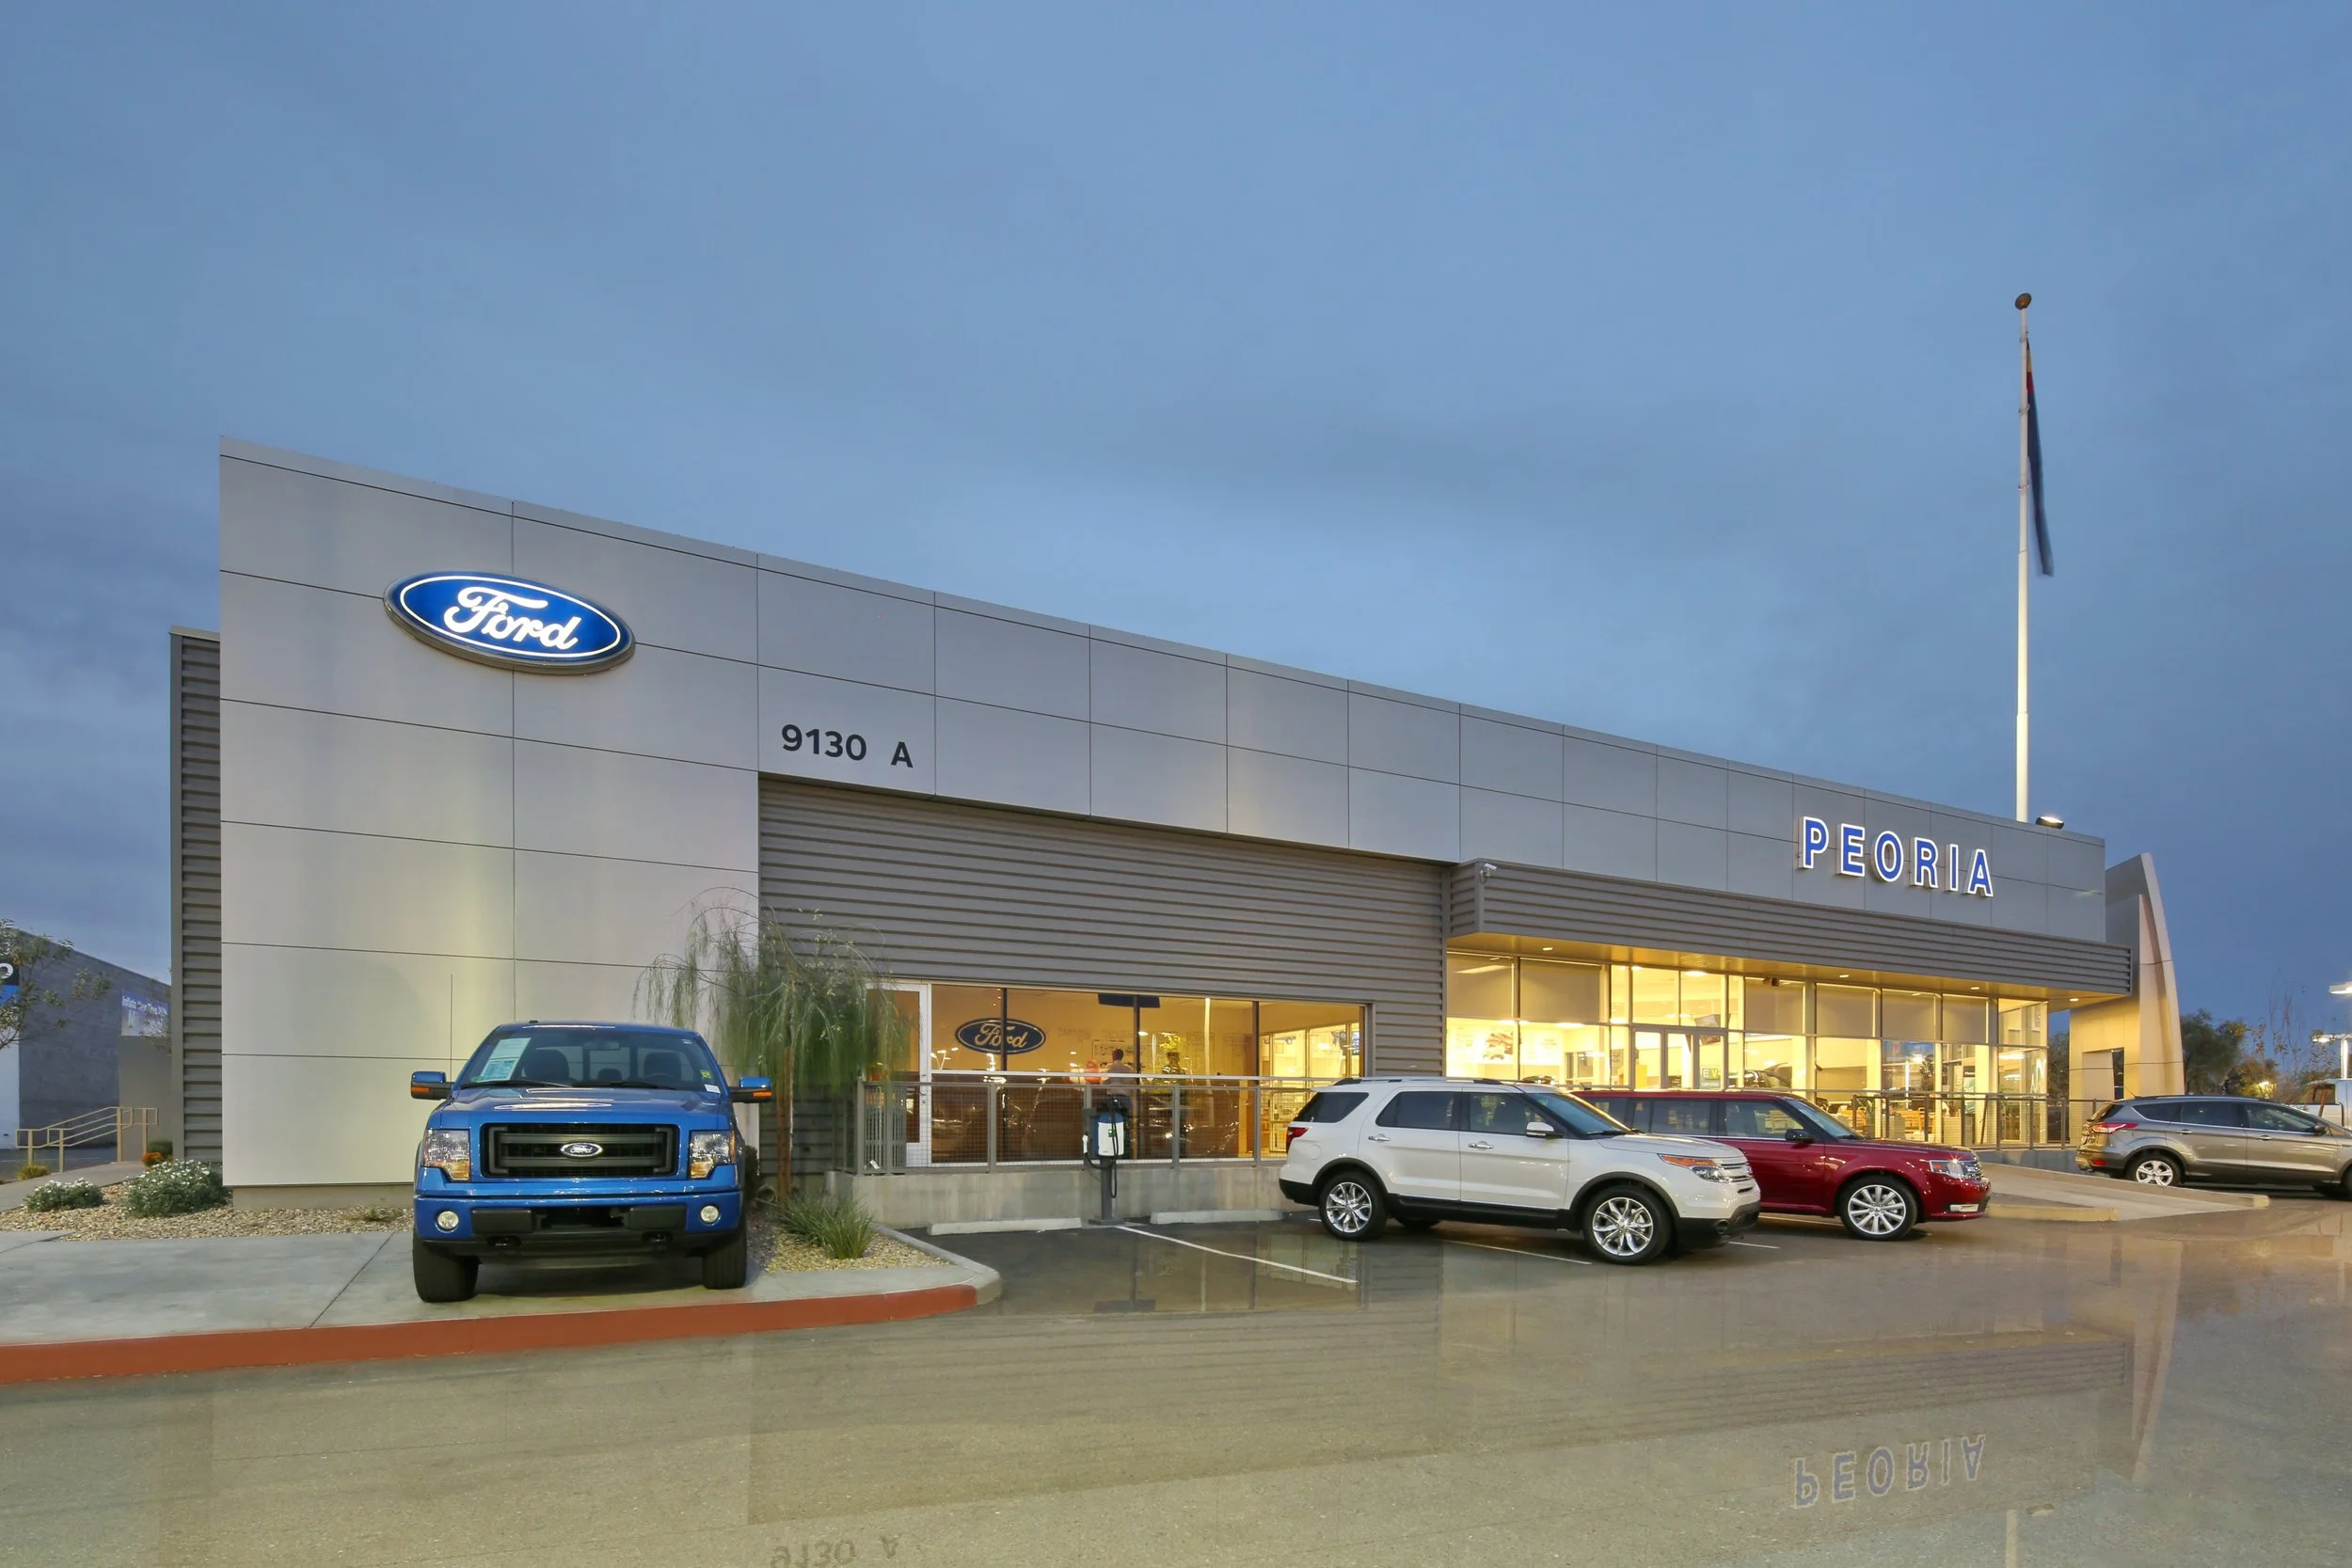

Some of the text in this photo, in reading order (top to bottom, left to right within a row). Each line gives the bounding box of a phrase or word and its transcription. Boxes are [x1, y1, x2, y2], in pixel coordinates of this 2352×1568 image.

[442, 585, 580, 651] Ford
[781, 723, 914, 768] 9130 A
[1798, 816, 1994, 897] PEORIA
[974, 1022, 1028, 1048] Ford
